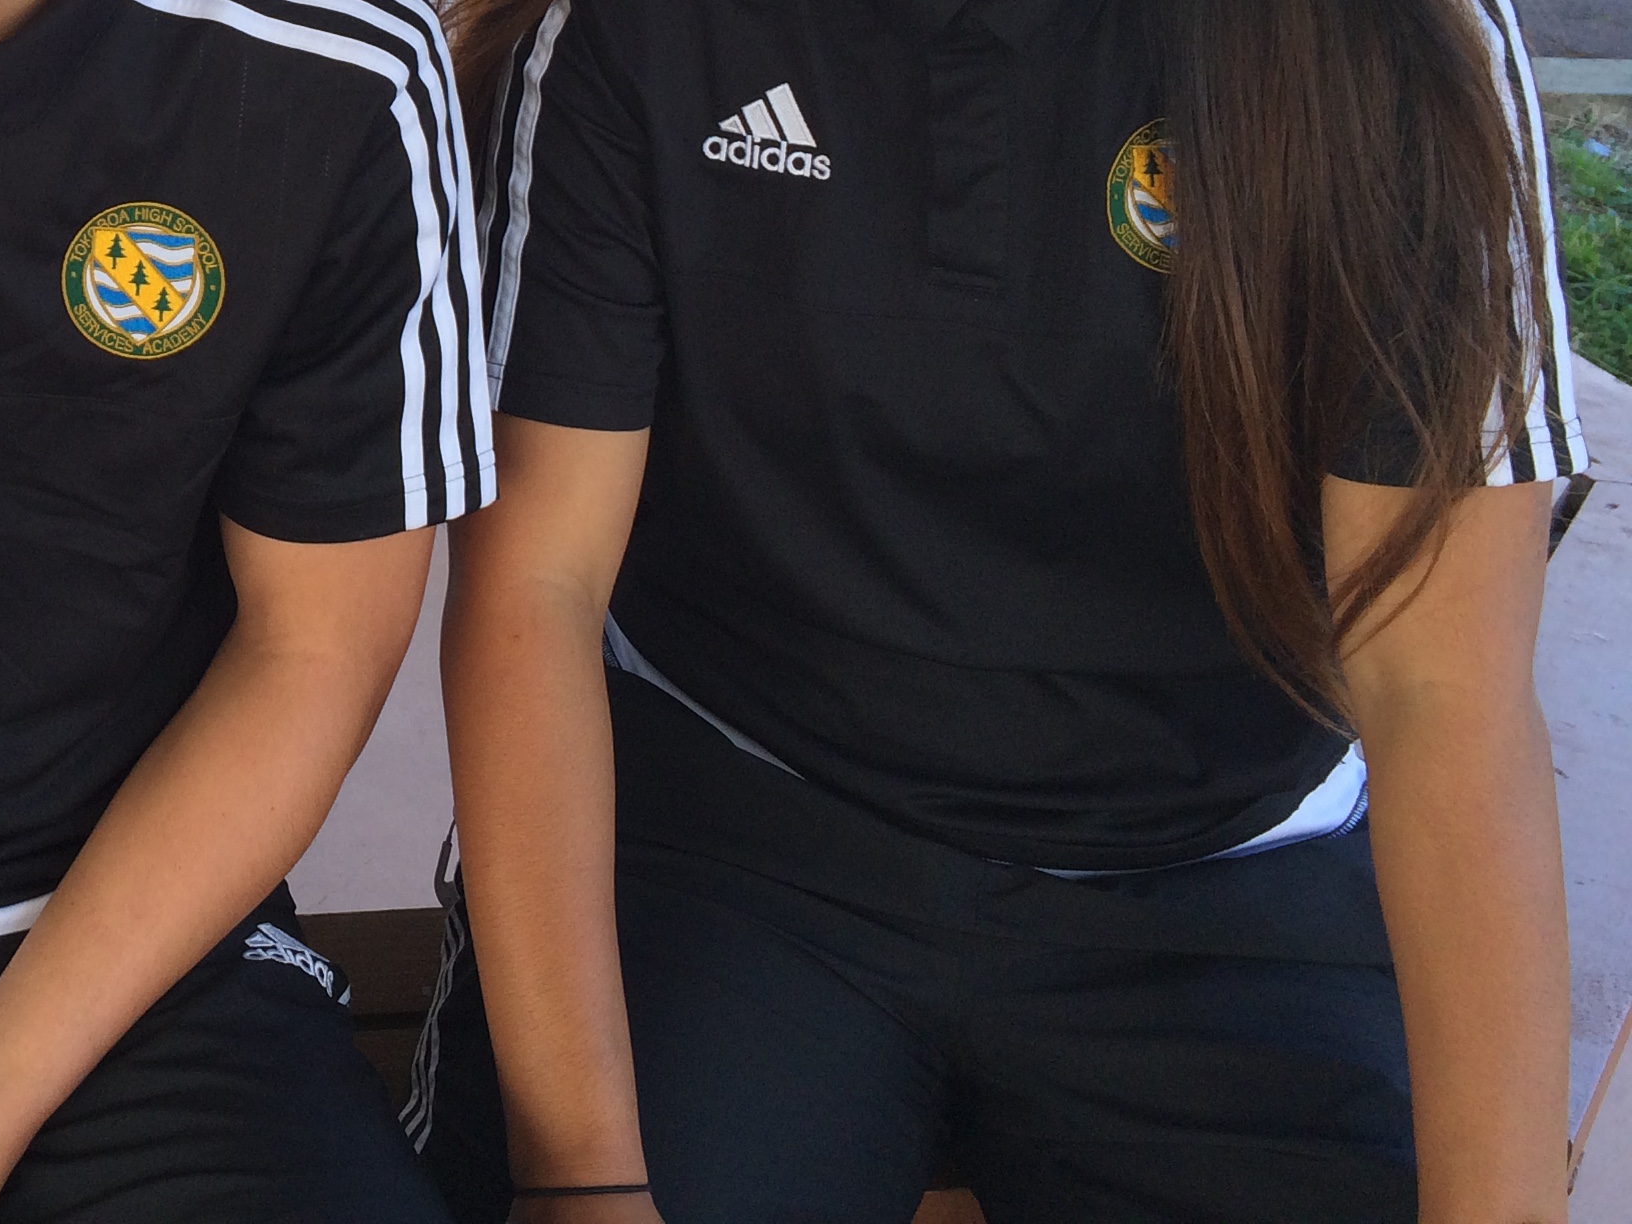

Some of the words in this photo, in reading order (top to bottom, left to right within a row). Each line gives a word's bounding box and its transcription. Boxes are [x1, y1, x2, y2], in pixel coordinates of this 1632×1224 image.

[702, 134, 831, 180] adidas
[134, 207, 171, 226] HIGH
[172, 217, 219, 275] SCOOL
[1116, 222, 1170, 268] SERVICE
[73, 303, 134, 353] SERVICES
[142, 313, 208, 355] ACADEMY
[241, 941, 334, 998] adidas
